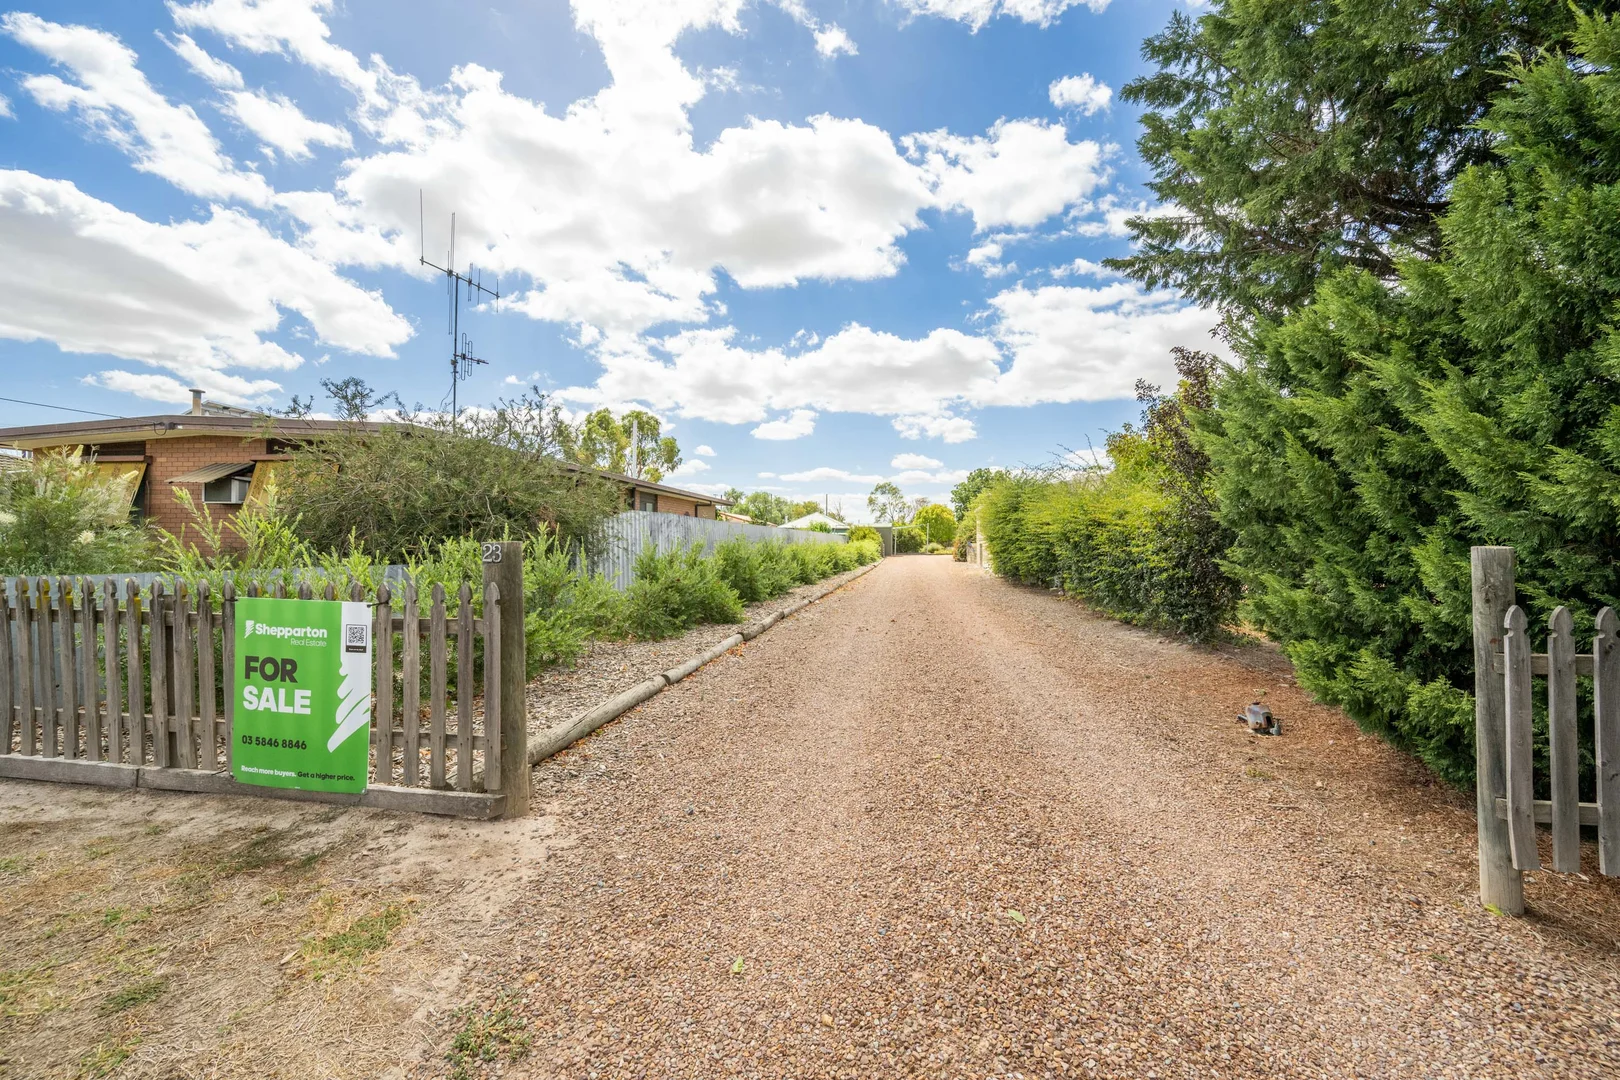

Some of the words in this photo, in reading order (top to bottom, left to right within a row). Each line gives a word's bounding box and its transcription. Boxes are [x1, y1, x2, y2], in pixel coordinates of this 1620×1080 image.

[483, 544, 501, 563] 23
[255, 623, 328, 639] Shepparton
[290, 638, 305, 646] Real
[305, 639, 327, 647] Estate
[244, 655, 298, 683] FOR
[242, 685, 312, 714] SALE
[242, 735, 253, 745] 03
[255, 737, 279, 748] 5846
[281, 739, 307, 750] 8846
[241, 765, 258, 773] Reach
[274, 769, 297, 777] buyers.
[315, 773, 336, 781] higher
